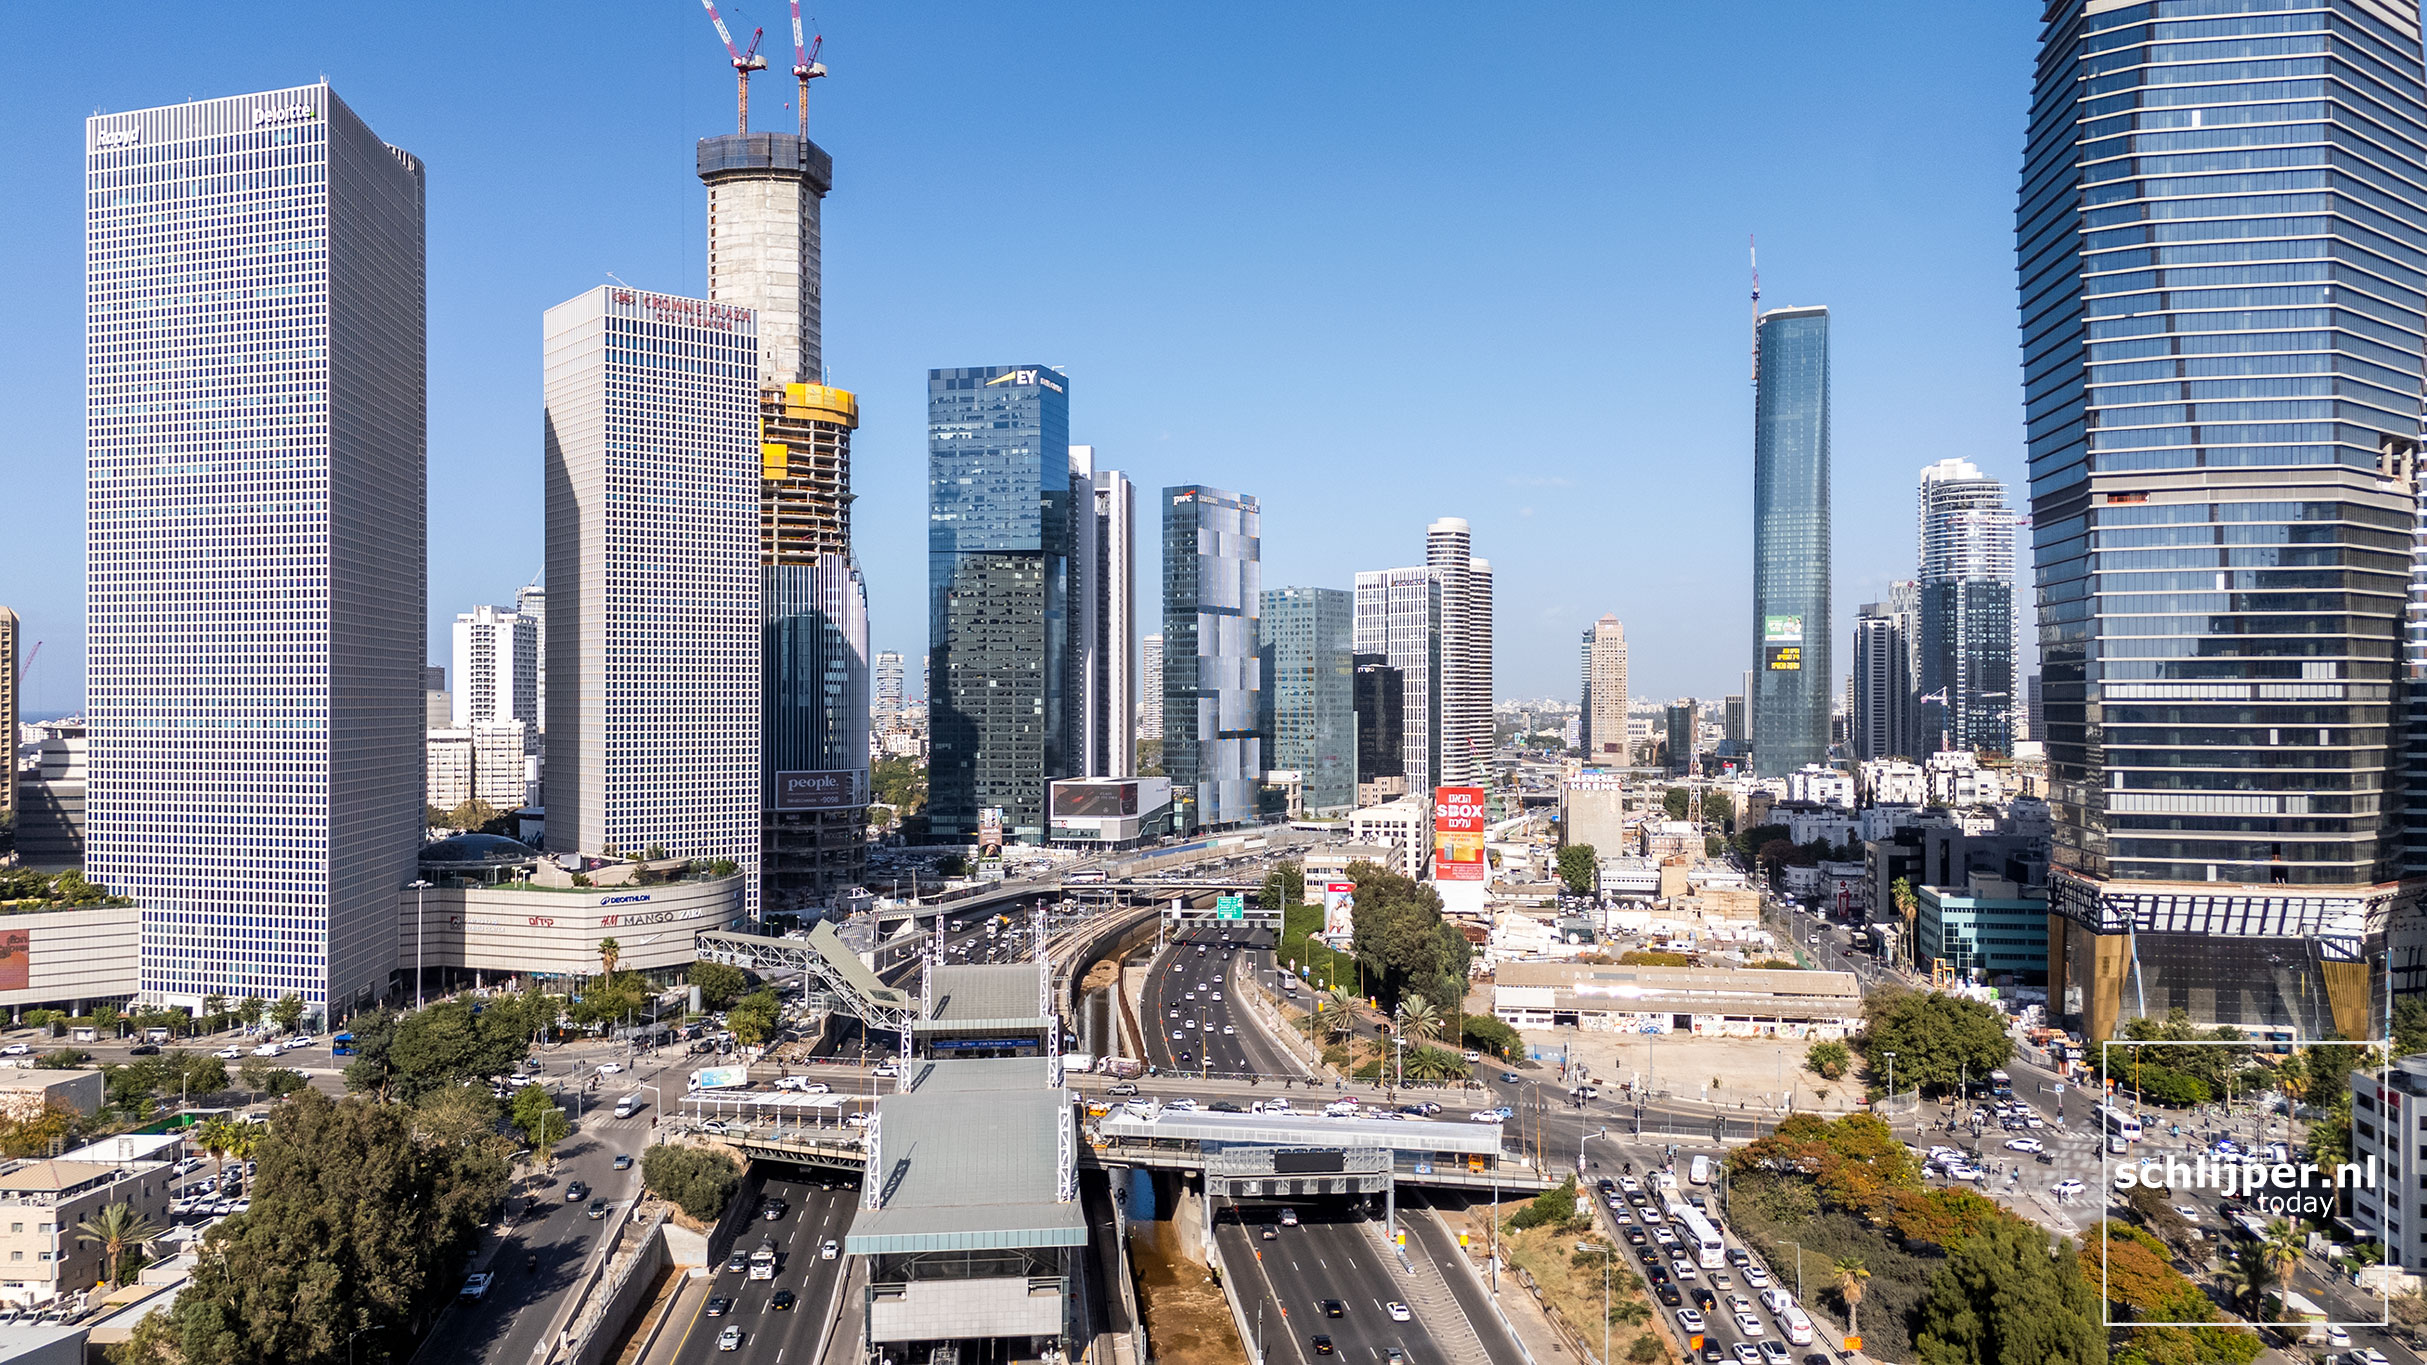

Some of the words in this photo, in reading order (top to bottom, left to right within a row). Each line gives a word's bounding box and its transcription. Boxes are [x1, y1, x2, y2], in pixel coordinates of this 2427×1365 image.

[254, 103, 315, 125] Deloitte.
[96, 125, 141, 148] Rapyd
[643, 295, 703, 315] CROWNE
[709, 305, 752, 323] PLAZA
[656, 312, 683, 325] CITY
[689, 316, 733, 331] CENTER
[1016, 369, 1038, 385] EY
[1173, 494, 1193, 506] pwc
[788, 775, 839, 791] people.
[1436, 804, 1483, 817] SBOX
[611, 895, 650, 904] DECATHLON
[601, 915, 619, 927] H&M
[624, 912, 674, 926] MANGO
[680, 909, 703, 920] ZARA
